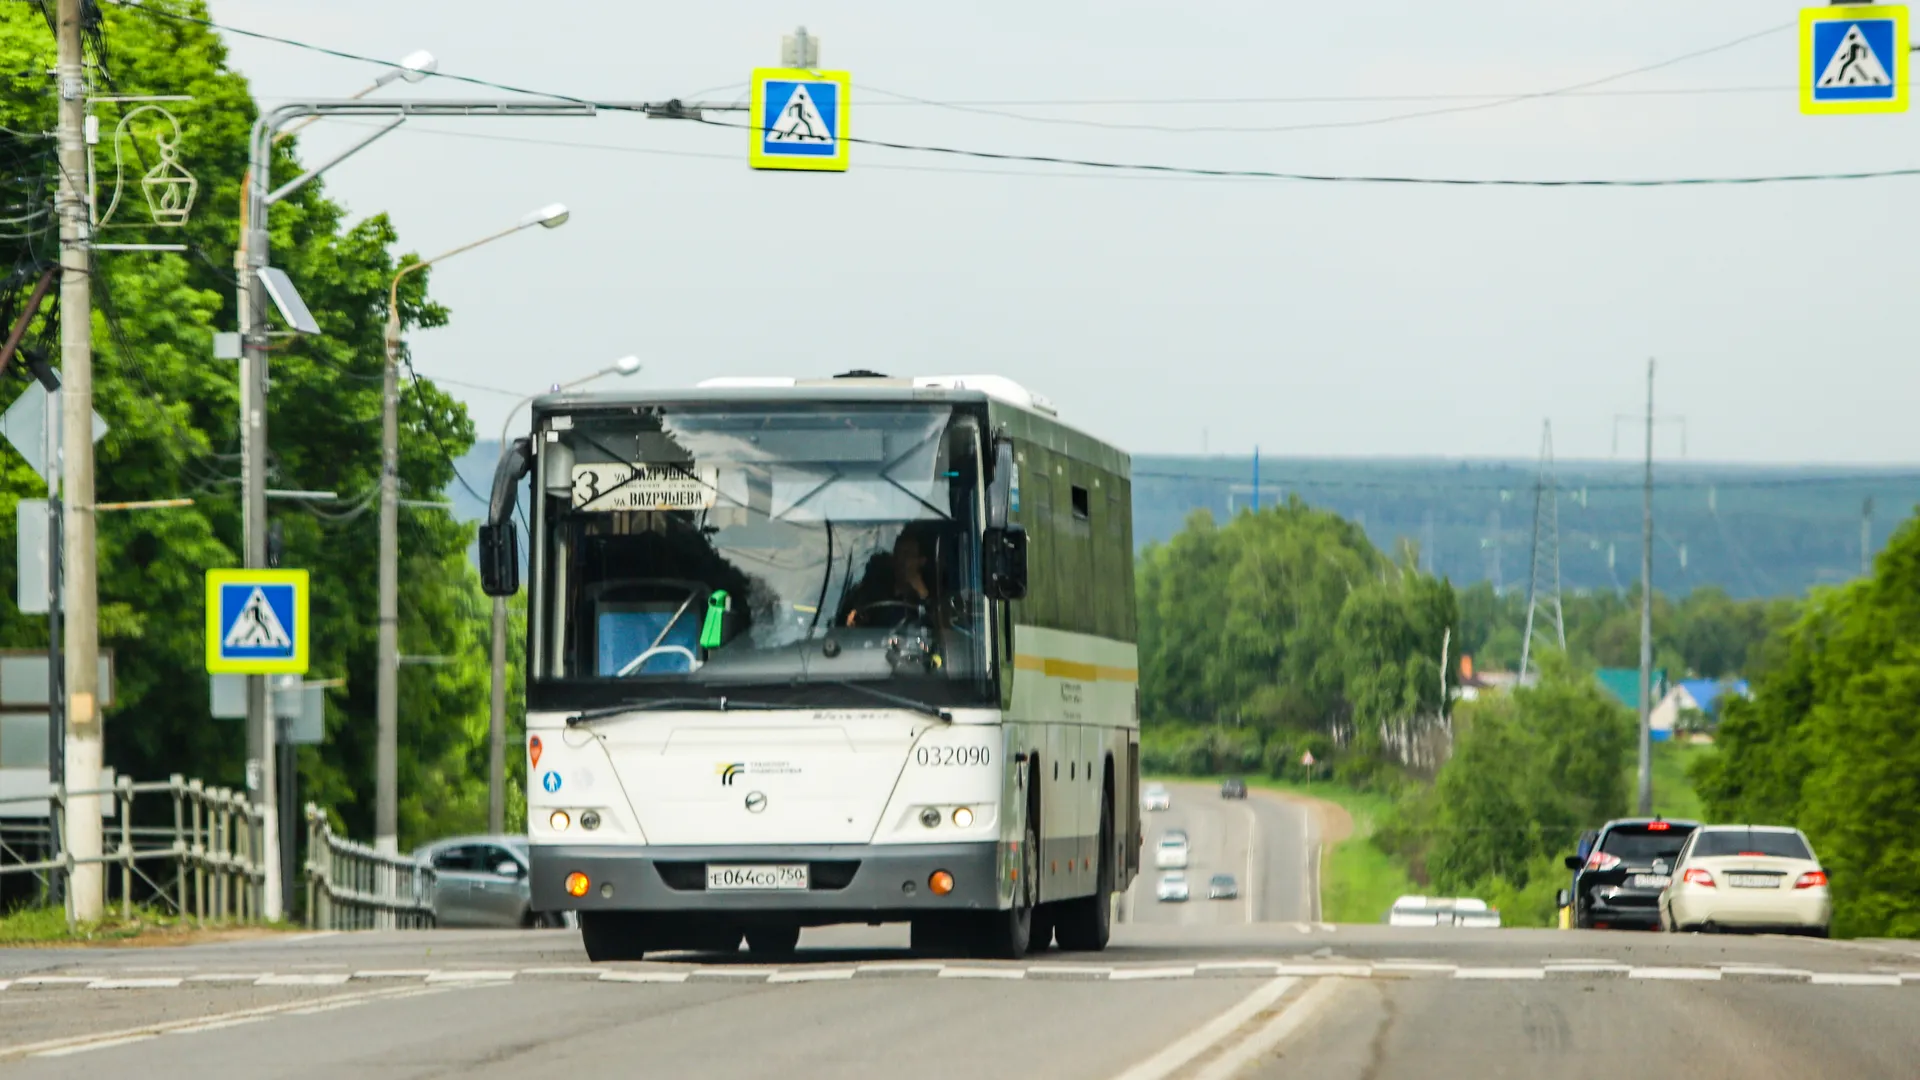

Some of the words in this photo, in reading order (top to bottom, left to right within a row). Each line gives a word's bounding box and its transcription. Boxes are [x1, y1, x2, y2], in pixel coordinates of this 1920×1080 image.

[577, 470, 600, 503] 3
[629, 491, 703, 507] ВАХРУШЕВА
[917, 745, 991, 766] 032090
